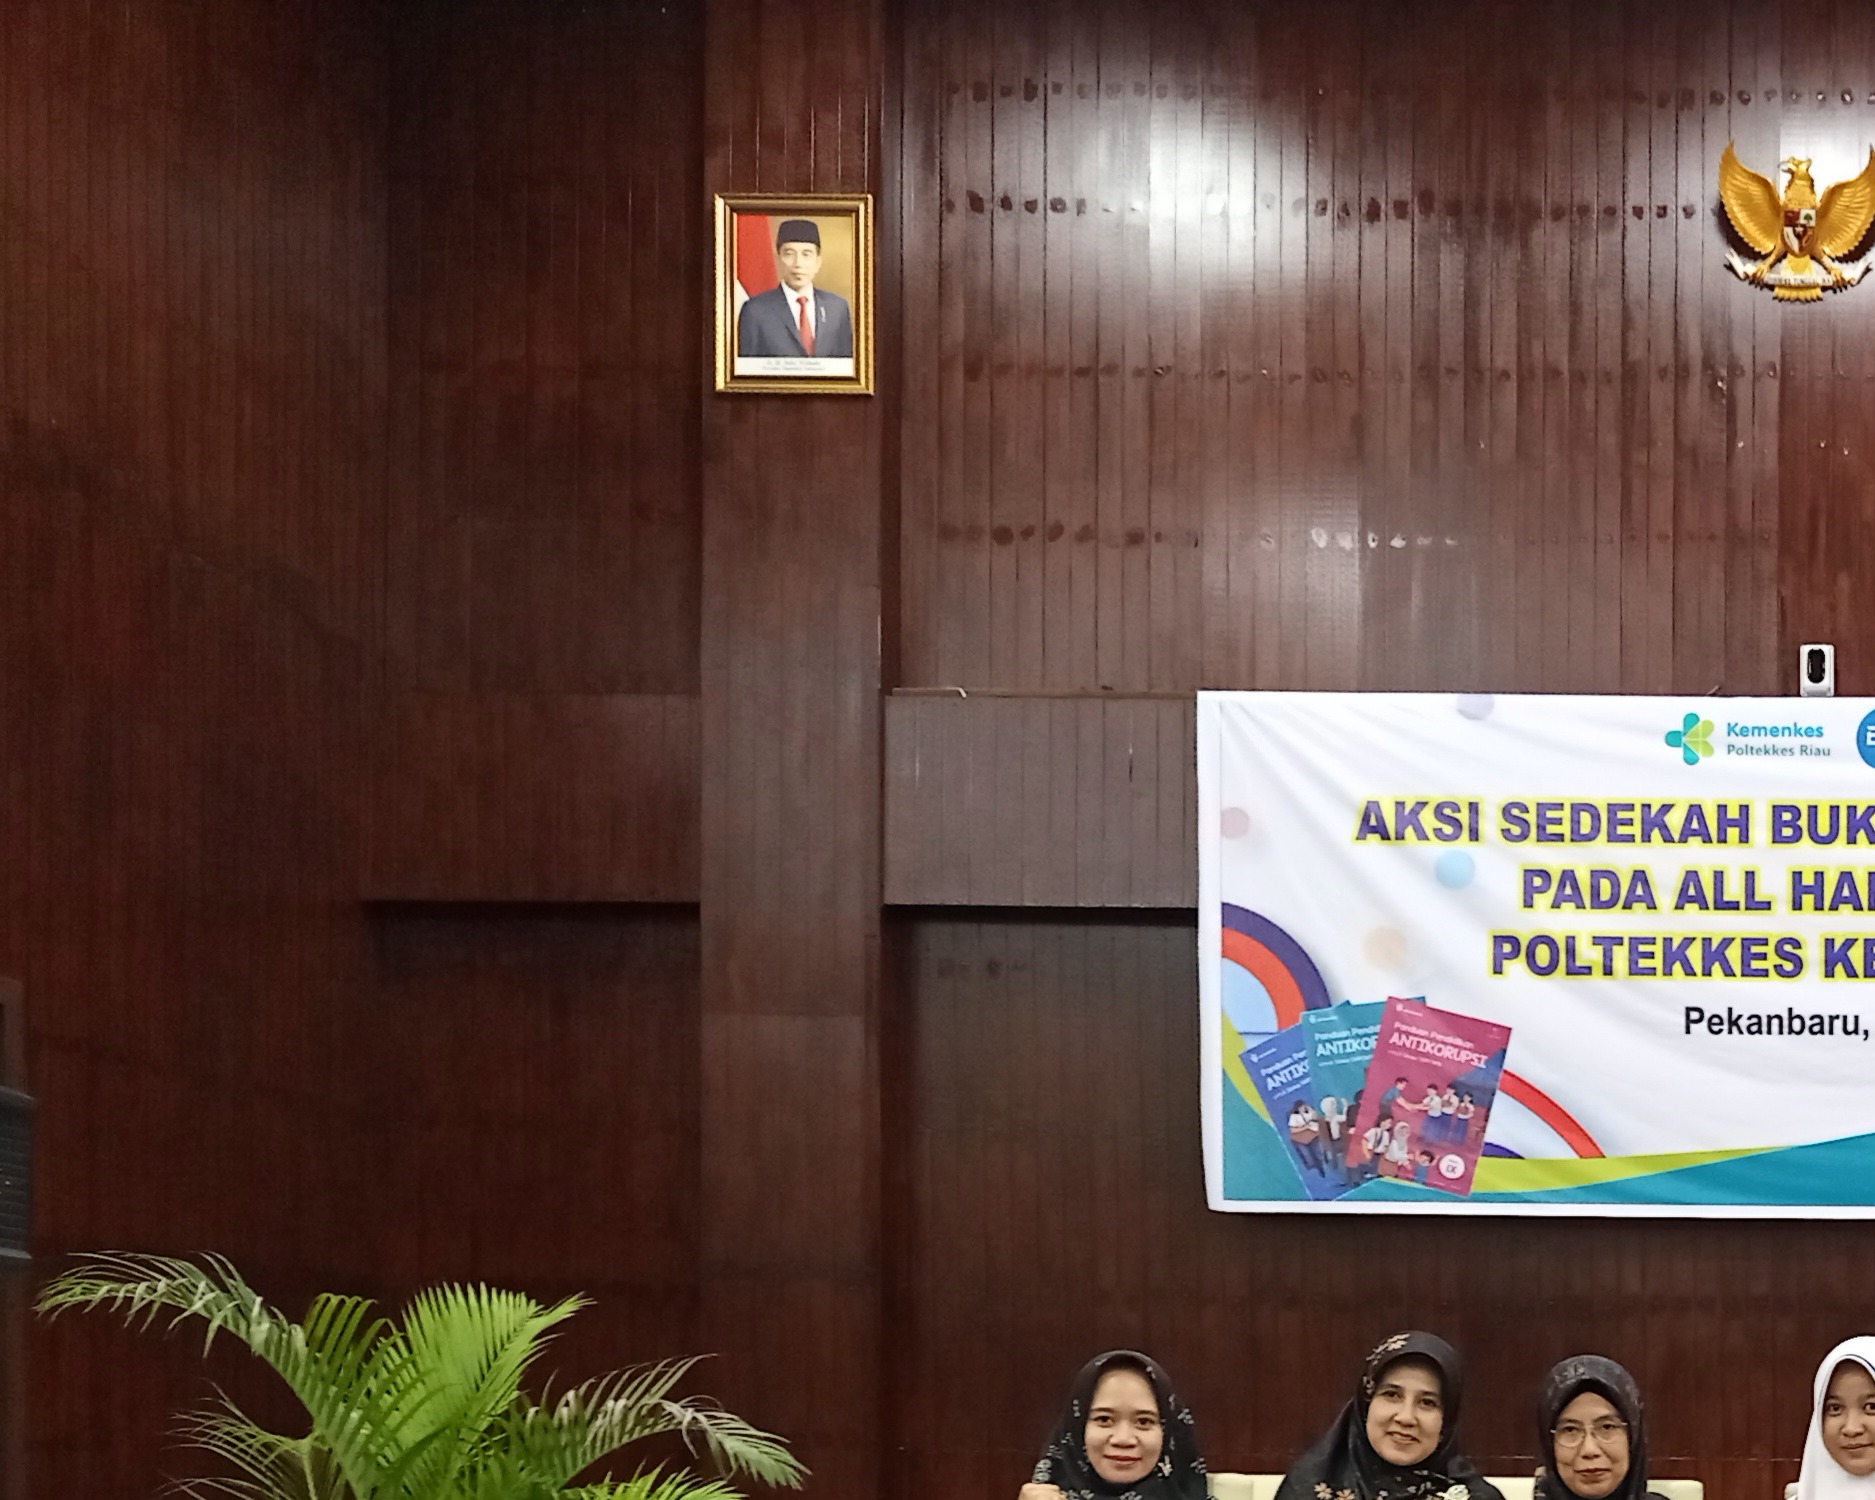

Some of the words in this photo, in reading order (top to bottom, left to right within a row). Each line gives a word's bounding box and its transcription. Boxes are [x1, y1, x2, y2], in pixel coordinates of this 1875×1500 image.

[1727, 722, 1824, 738] Kemenkes
[1727, 744, 1795, 757] Poltekkes
[1799, 744, 1831, 757] Riau
[1355, 801, 1480, 842] AKSI
[1501, 802, 1749, 845] SEDEKAH
[1523, 868, 1657, 910] PADA
[1674, 870, 1772, 911] ALL
[1492, 934, 1803, 977] POLTEKKES
[1684, 1007, 1871, 1041] Pekanbaru,
[1388, 1031, 1489, 1069] ANTIKORUPSI
